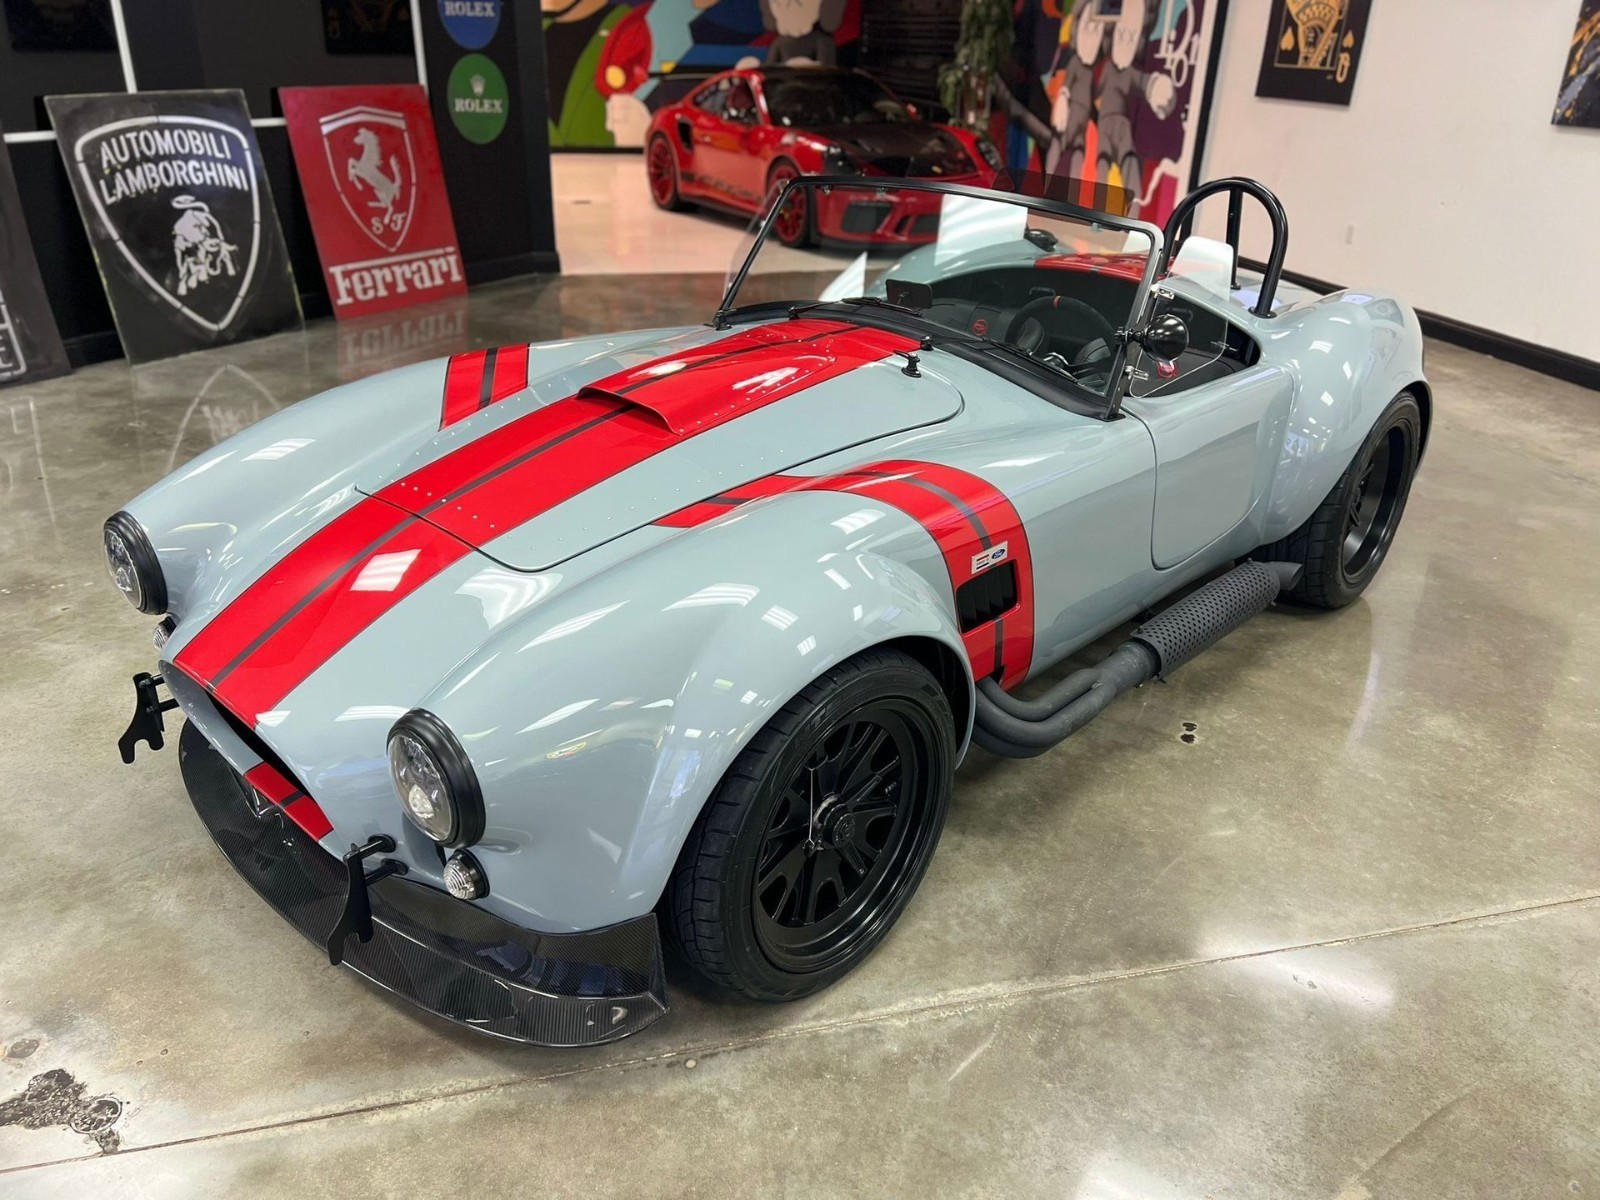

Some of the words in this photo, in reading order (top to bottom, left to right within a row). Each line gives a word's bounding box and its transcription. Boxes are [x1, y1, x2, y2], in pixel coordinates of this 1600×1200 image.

[444, 0, 495, 17] ROLEX
[454, 98, 503, 114] ROLEX
[100, 129, 230, 170] AUTOMOBILI
[100, 159, 249, 205] LAMBORGHINI
[371, 216, 384, 235] S
[328, 246, 463, 306] Ferrari
